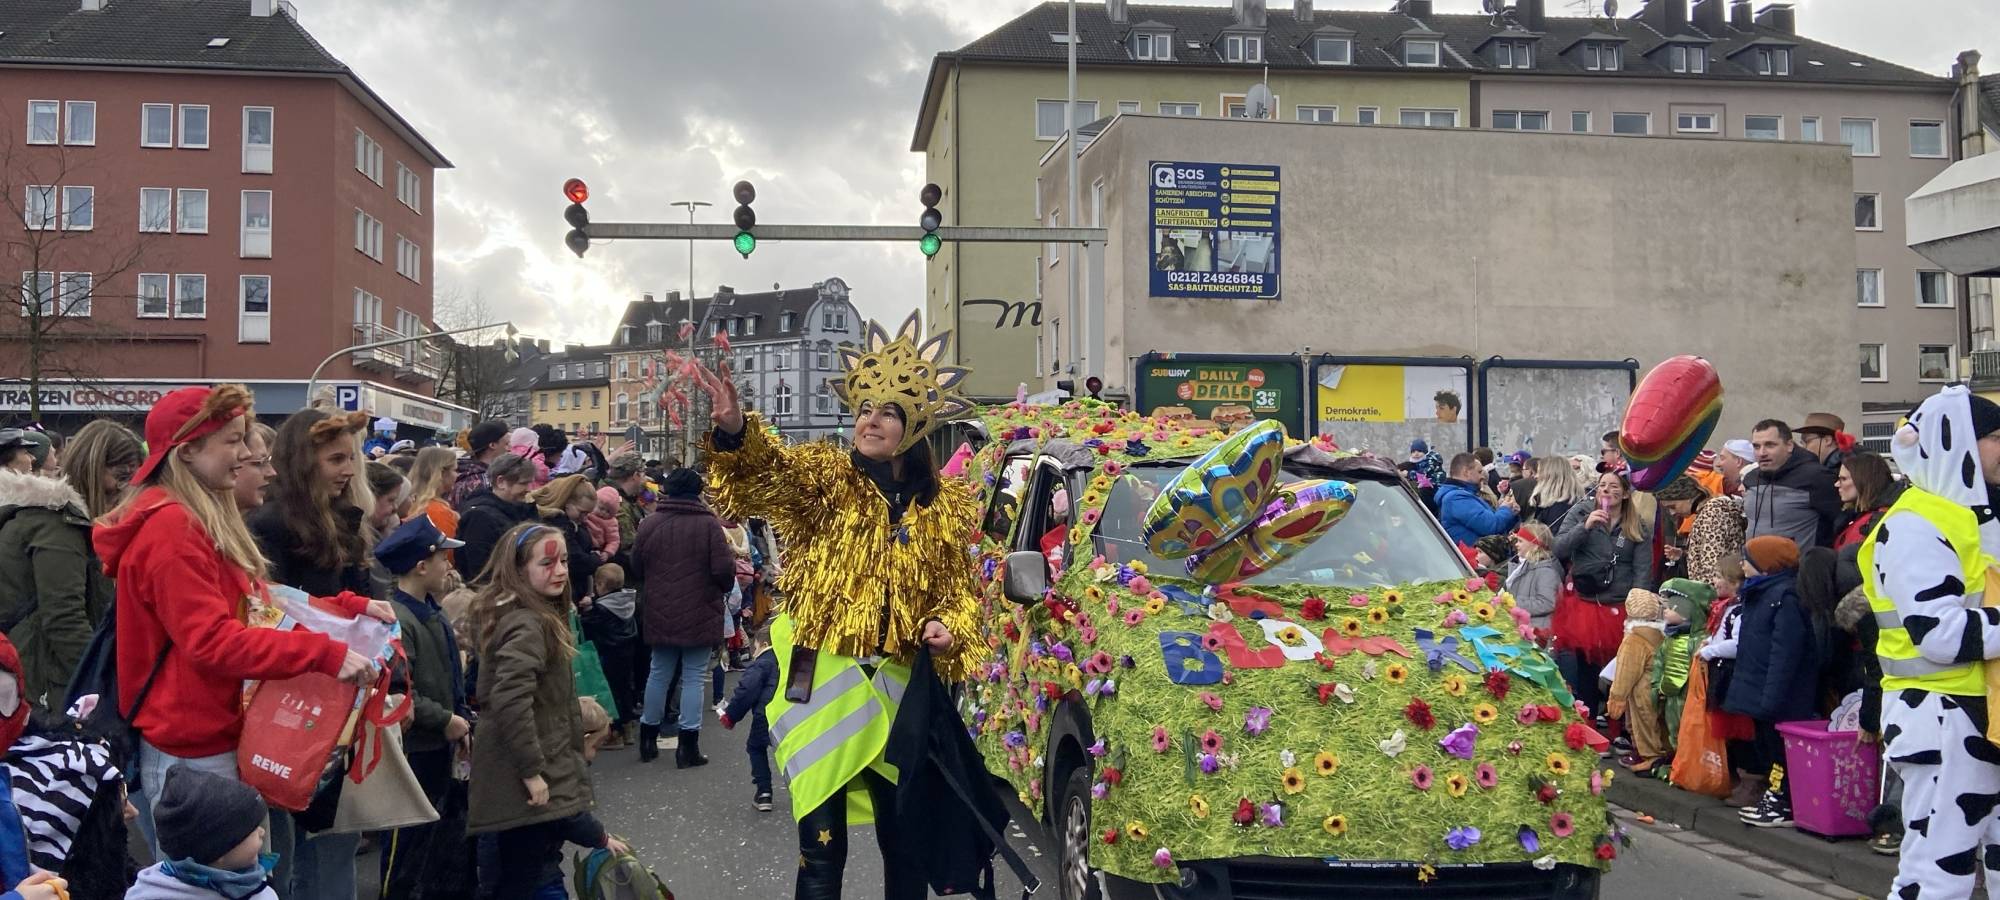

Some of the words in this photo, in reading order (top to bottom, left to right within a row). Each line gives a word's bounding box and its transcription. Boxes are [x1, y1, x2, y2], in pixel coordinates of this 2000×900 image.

[1177, 168, 1205, 180] sas
[1156, 209, 1205, 217] LANGFRISTIGE
[1157, 218, 1217, 226] WERTERHALTUNG
[1167, 271, 1200, 284] (0212)
[1203, 273, 1264, 285] 24926845
[1168, 283, 1263, 293] SAS-BAUTENSCHUTZ.DE
[1151, 369, 1191, 377] SUBWAY
[1199, 370, 1239, 381] DAILY
[1248, 374, 1264, 382] NEU
[1196, 383, 1250, 399] DEALS
[0, 390, 71, 405] TRAZEN
[340, 388, 357, 409] P
[1325, 406, 1381, 416] Demokratie,
[251, 753, 293, 779] REWE
